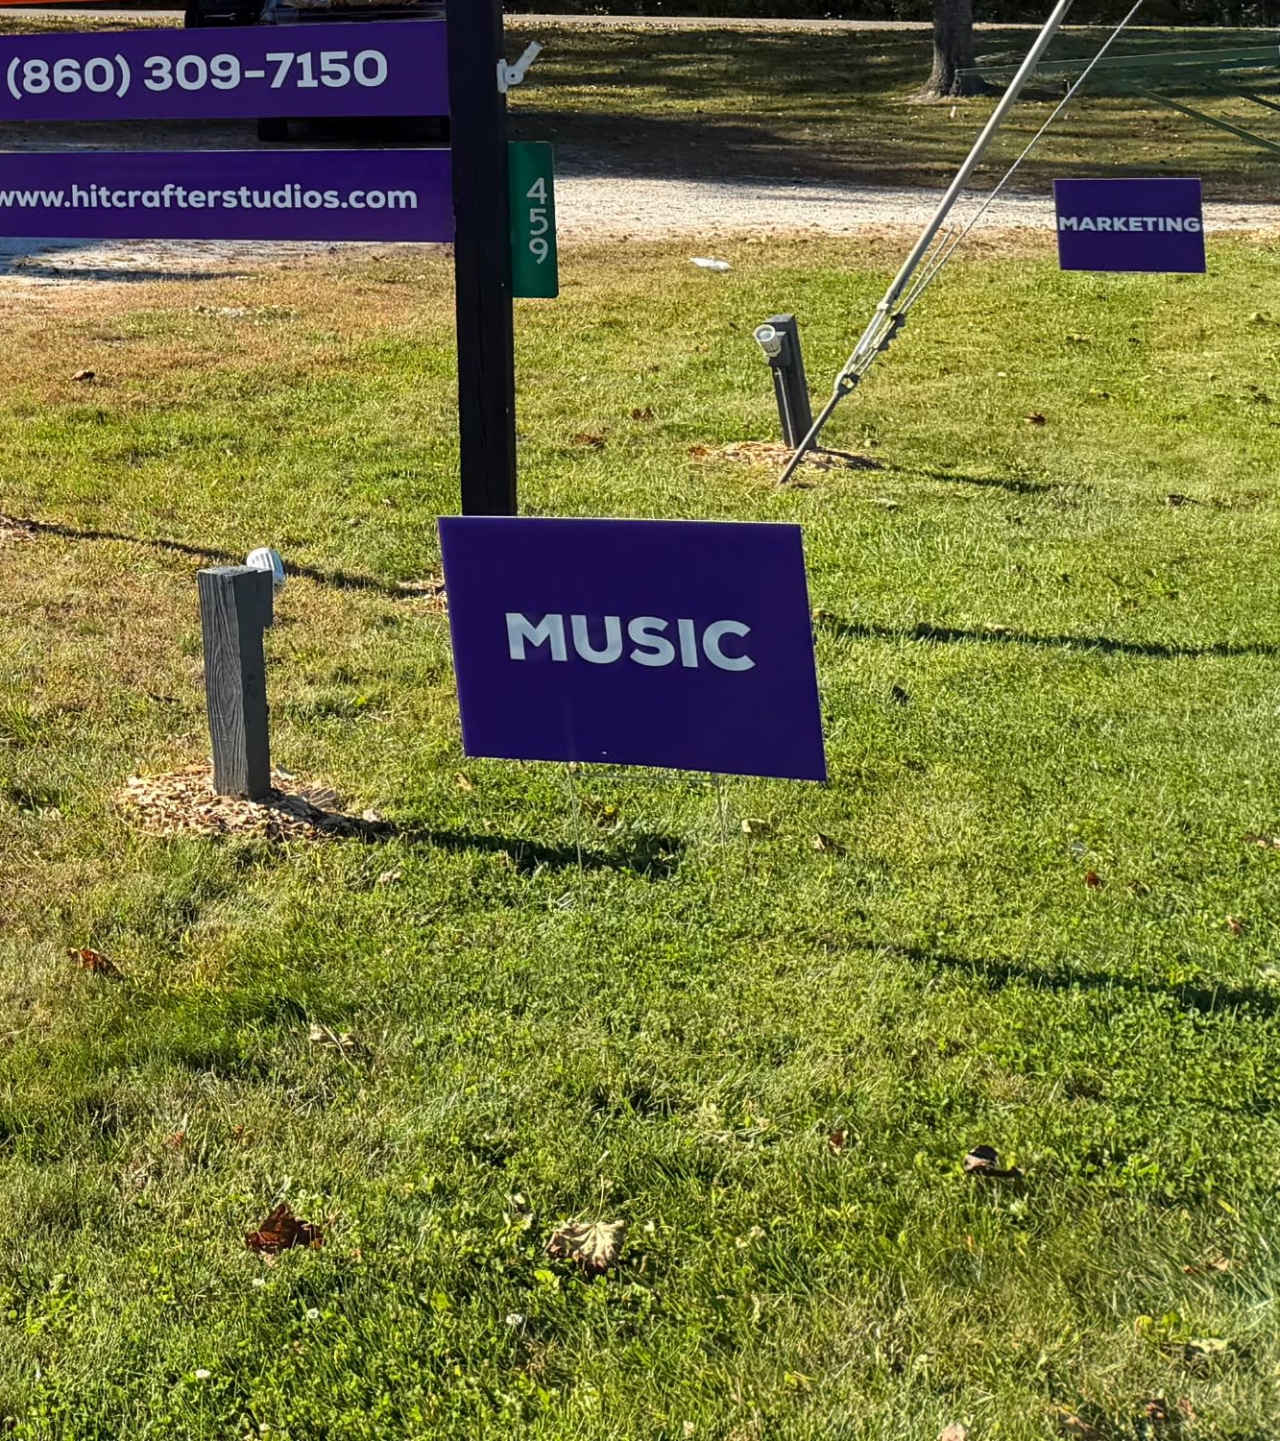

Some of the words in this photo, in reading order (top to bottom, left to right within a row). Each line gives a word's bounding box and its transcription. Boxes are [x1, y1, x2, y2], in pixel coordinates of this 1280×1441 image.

[6, 53, 131, 101] (860)
[143, 50, 389, 92] 309-7150
[526, 177, 549, 265] 459
[1059, 216, 1201, 232] MARKETING
[505, 613, 757, 672] MUSIC
